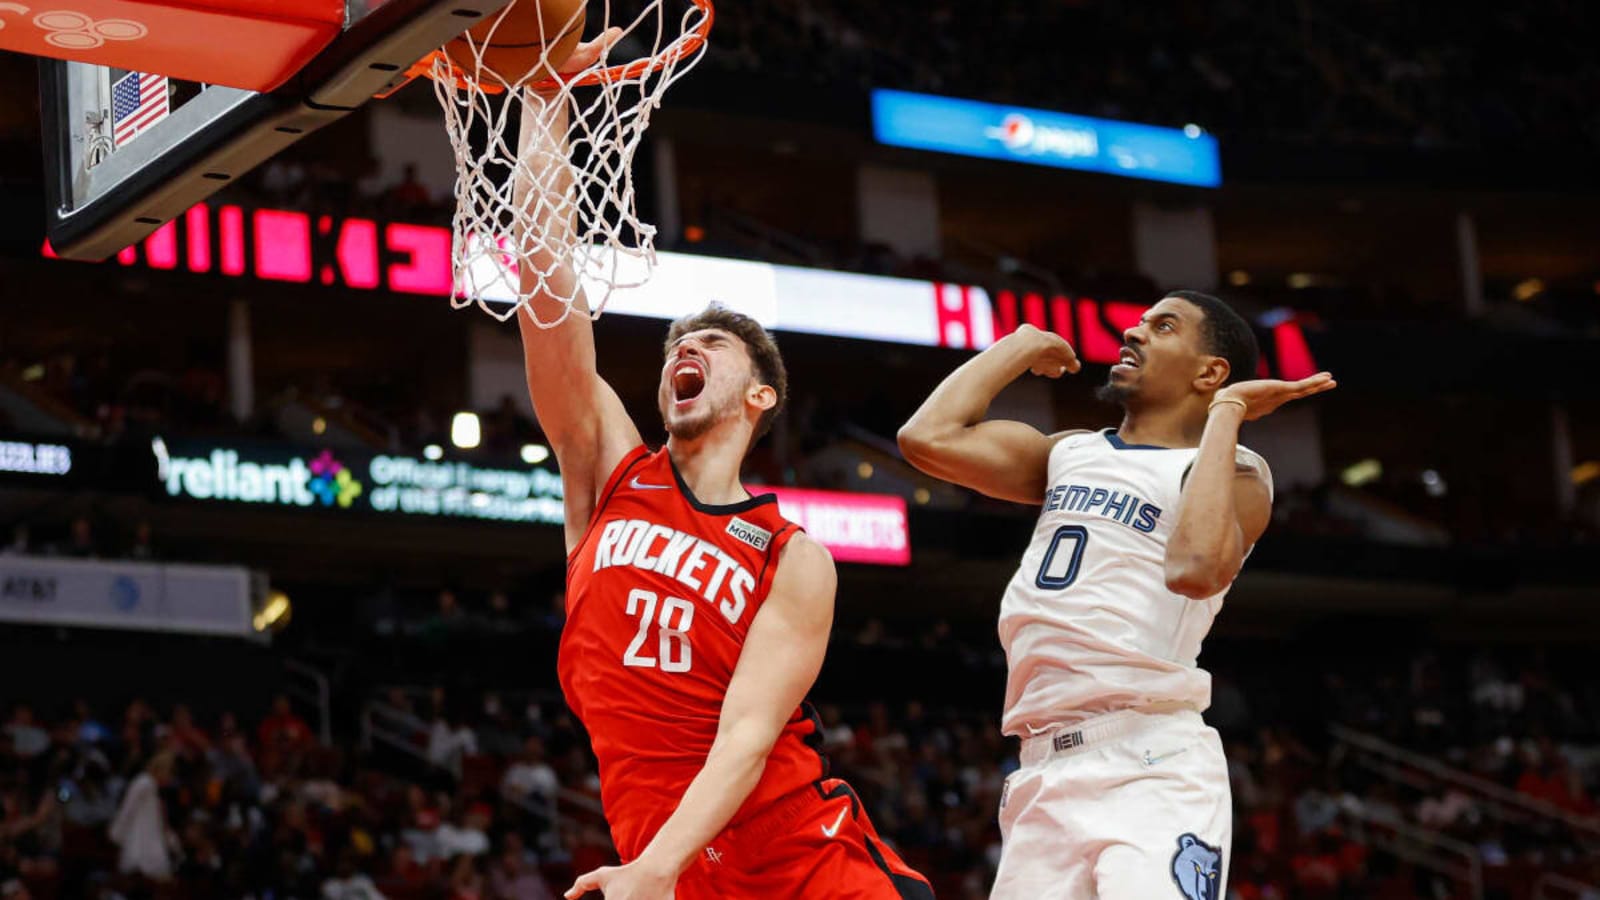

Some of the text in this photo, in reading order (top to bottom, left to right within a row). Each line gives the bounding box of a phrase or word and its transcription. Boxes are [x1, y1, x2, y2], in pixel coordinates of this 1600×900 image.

[166, 448, 315, 506] reliant
[728, 524, 767, 549] MONEY
[1035, 525, 1089, 591] 0
[593, 519, 756, 625] ROCKETS
[623, 588, 695, 673] 28
